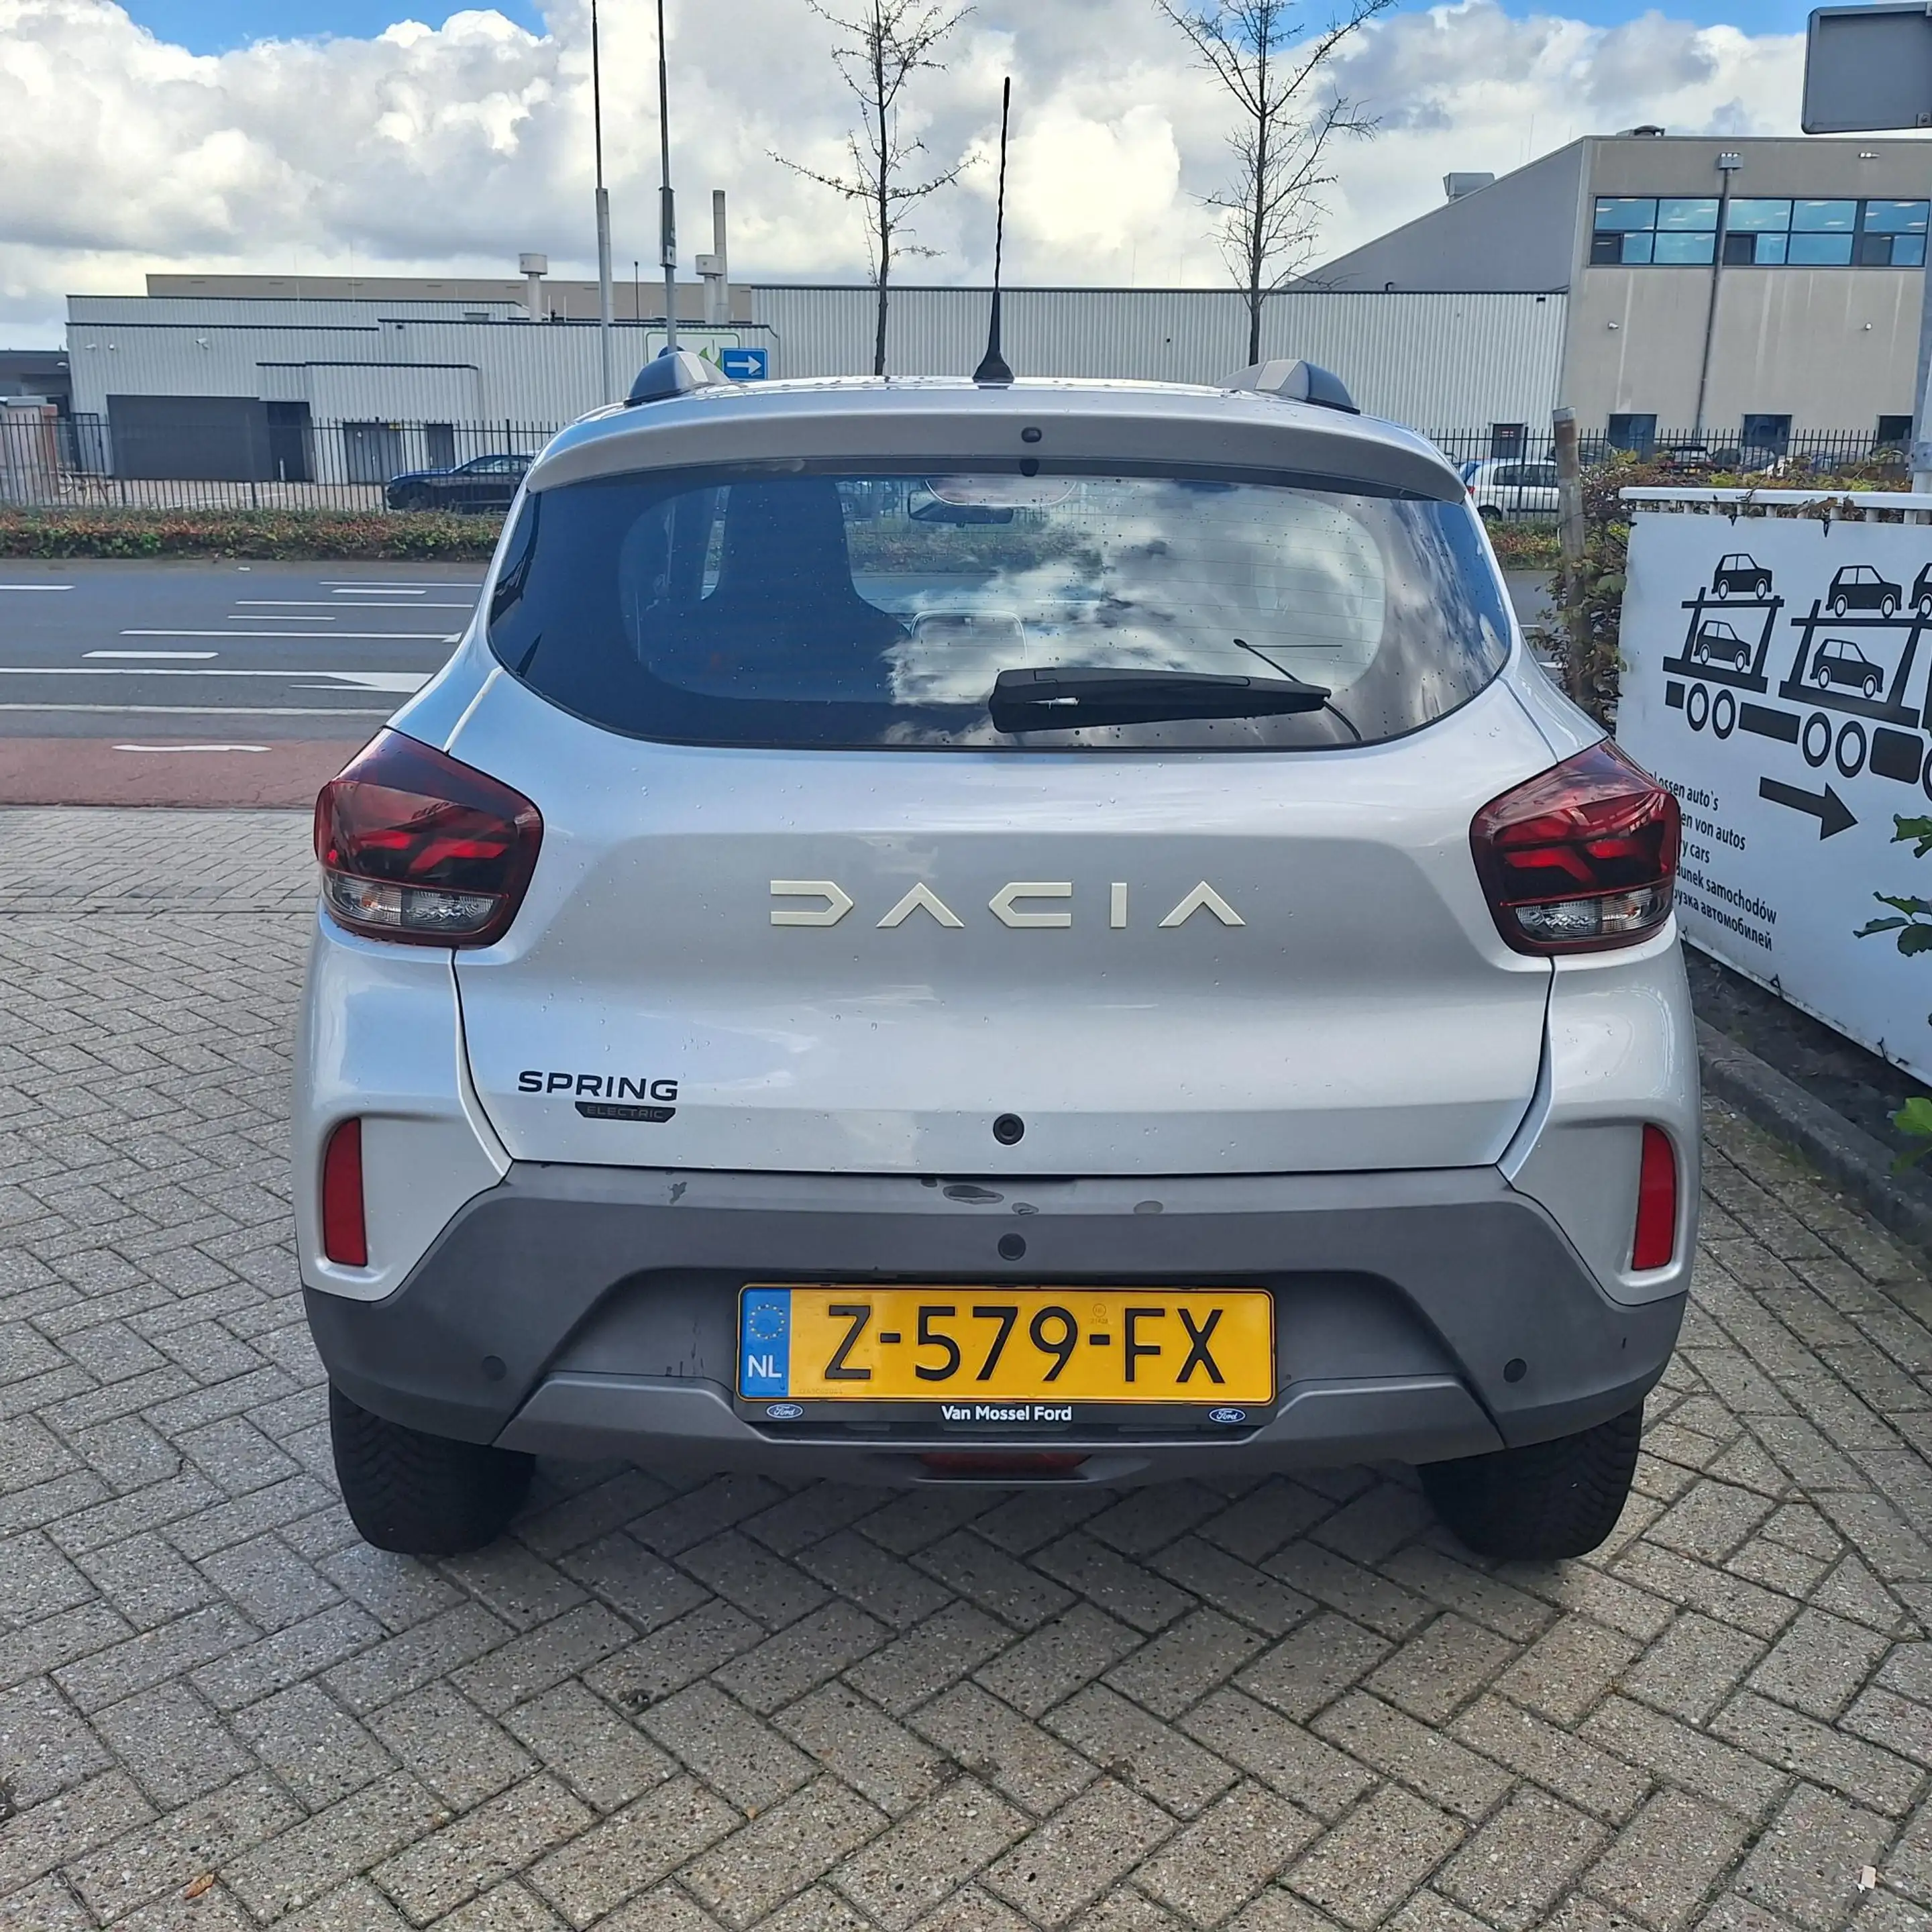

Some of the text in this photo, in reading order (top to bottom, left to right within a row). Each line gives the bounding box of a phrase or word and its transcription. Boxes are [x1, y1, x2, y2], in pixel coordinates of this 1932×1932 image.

[1695, 818, 1714, 837] von
[1716, 826, 1746, 851] autos
[1690, 843, 1710, 863] cars
[770, 880, 1246, 928] DACIA
[1706, 878, 1777, 924] samochodów
[1701, 902, 1772, 951] автомобилей
[517, 1070, 679, 1102] SPRING
[586, 1106, 664, 1120] ELECTRIC
[747, 1303, 1226, 1385] NL Z-579-FX
[941, 1405, 1072, 1421] Van Mossel Ford
